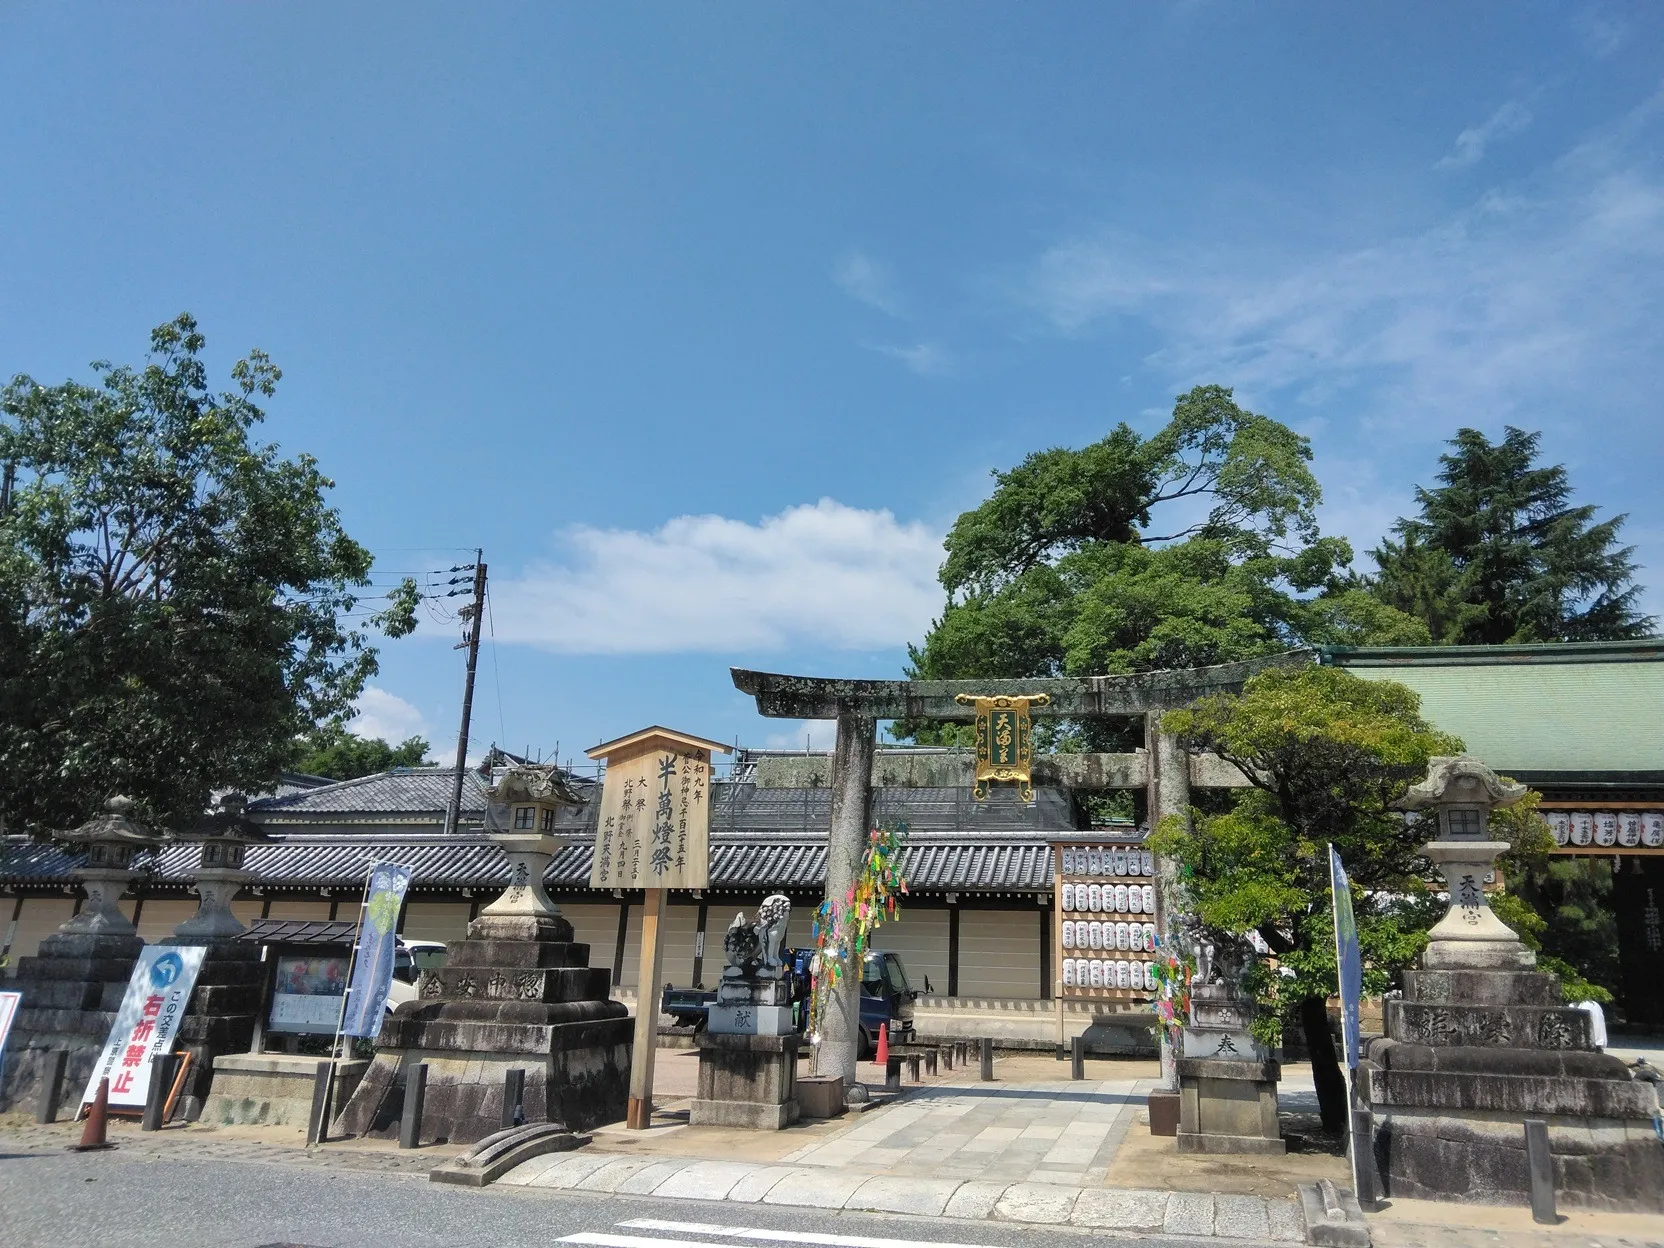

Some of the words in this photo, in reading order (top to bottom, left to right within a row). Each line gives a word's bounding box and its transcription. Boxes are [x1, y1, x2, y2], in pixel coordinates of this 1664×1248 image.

[621, 778, 634, 811] 北野祭
[693, 749, 705, 804] 令和九年
[649, 753, 678, 876] 半萬燈祭
[675, 752, 691, 874] 菅公御神忌千百二十五年
[600, 816, 615, 882] 北野天満宮
[617, 840, 628, 878] 九月四日
[1459, 875, 1482, 926] 天満宮
[111, 994, 165, 1093] 右折禁止
[147, 990, 181, 1063] この交差点は
[735, 1010, 752, 1028] 献
[1216, 1034, 1238, 1053] 奉
